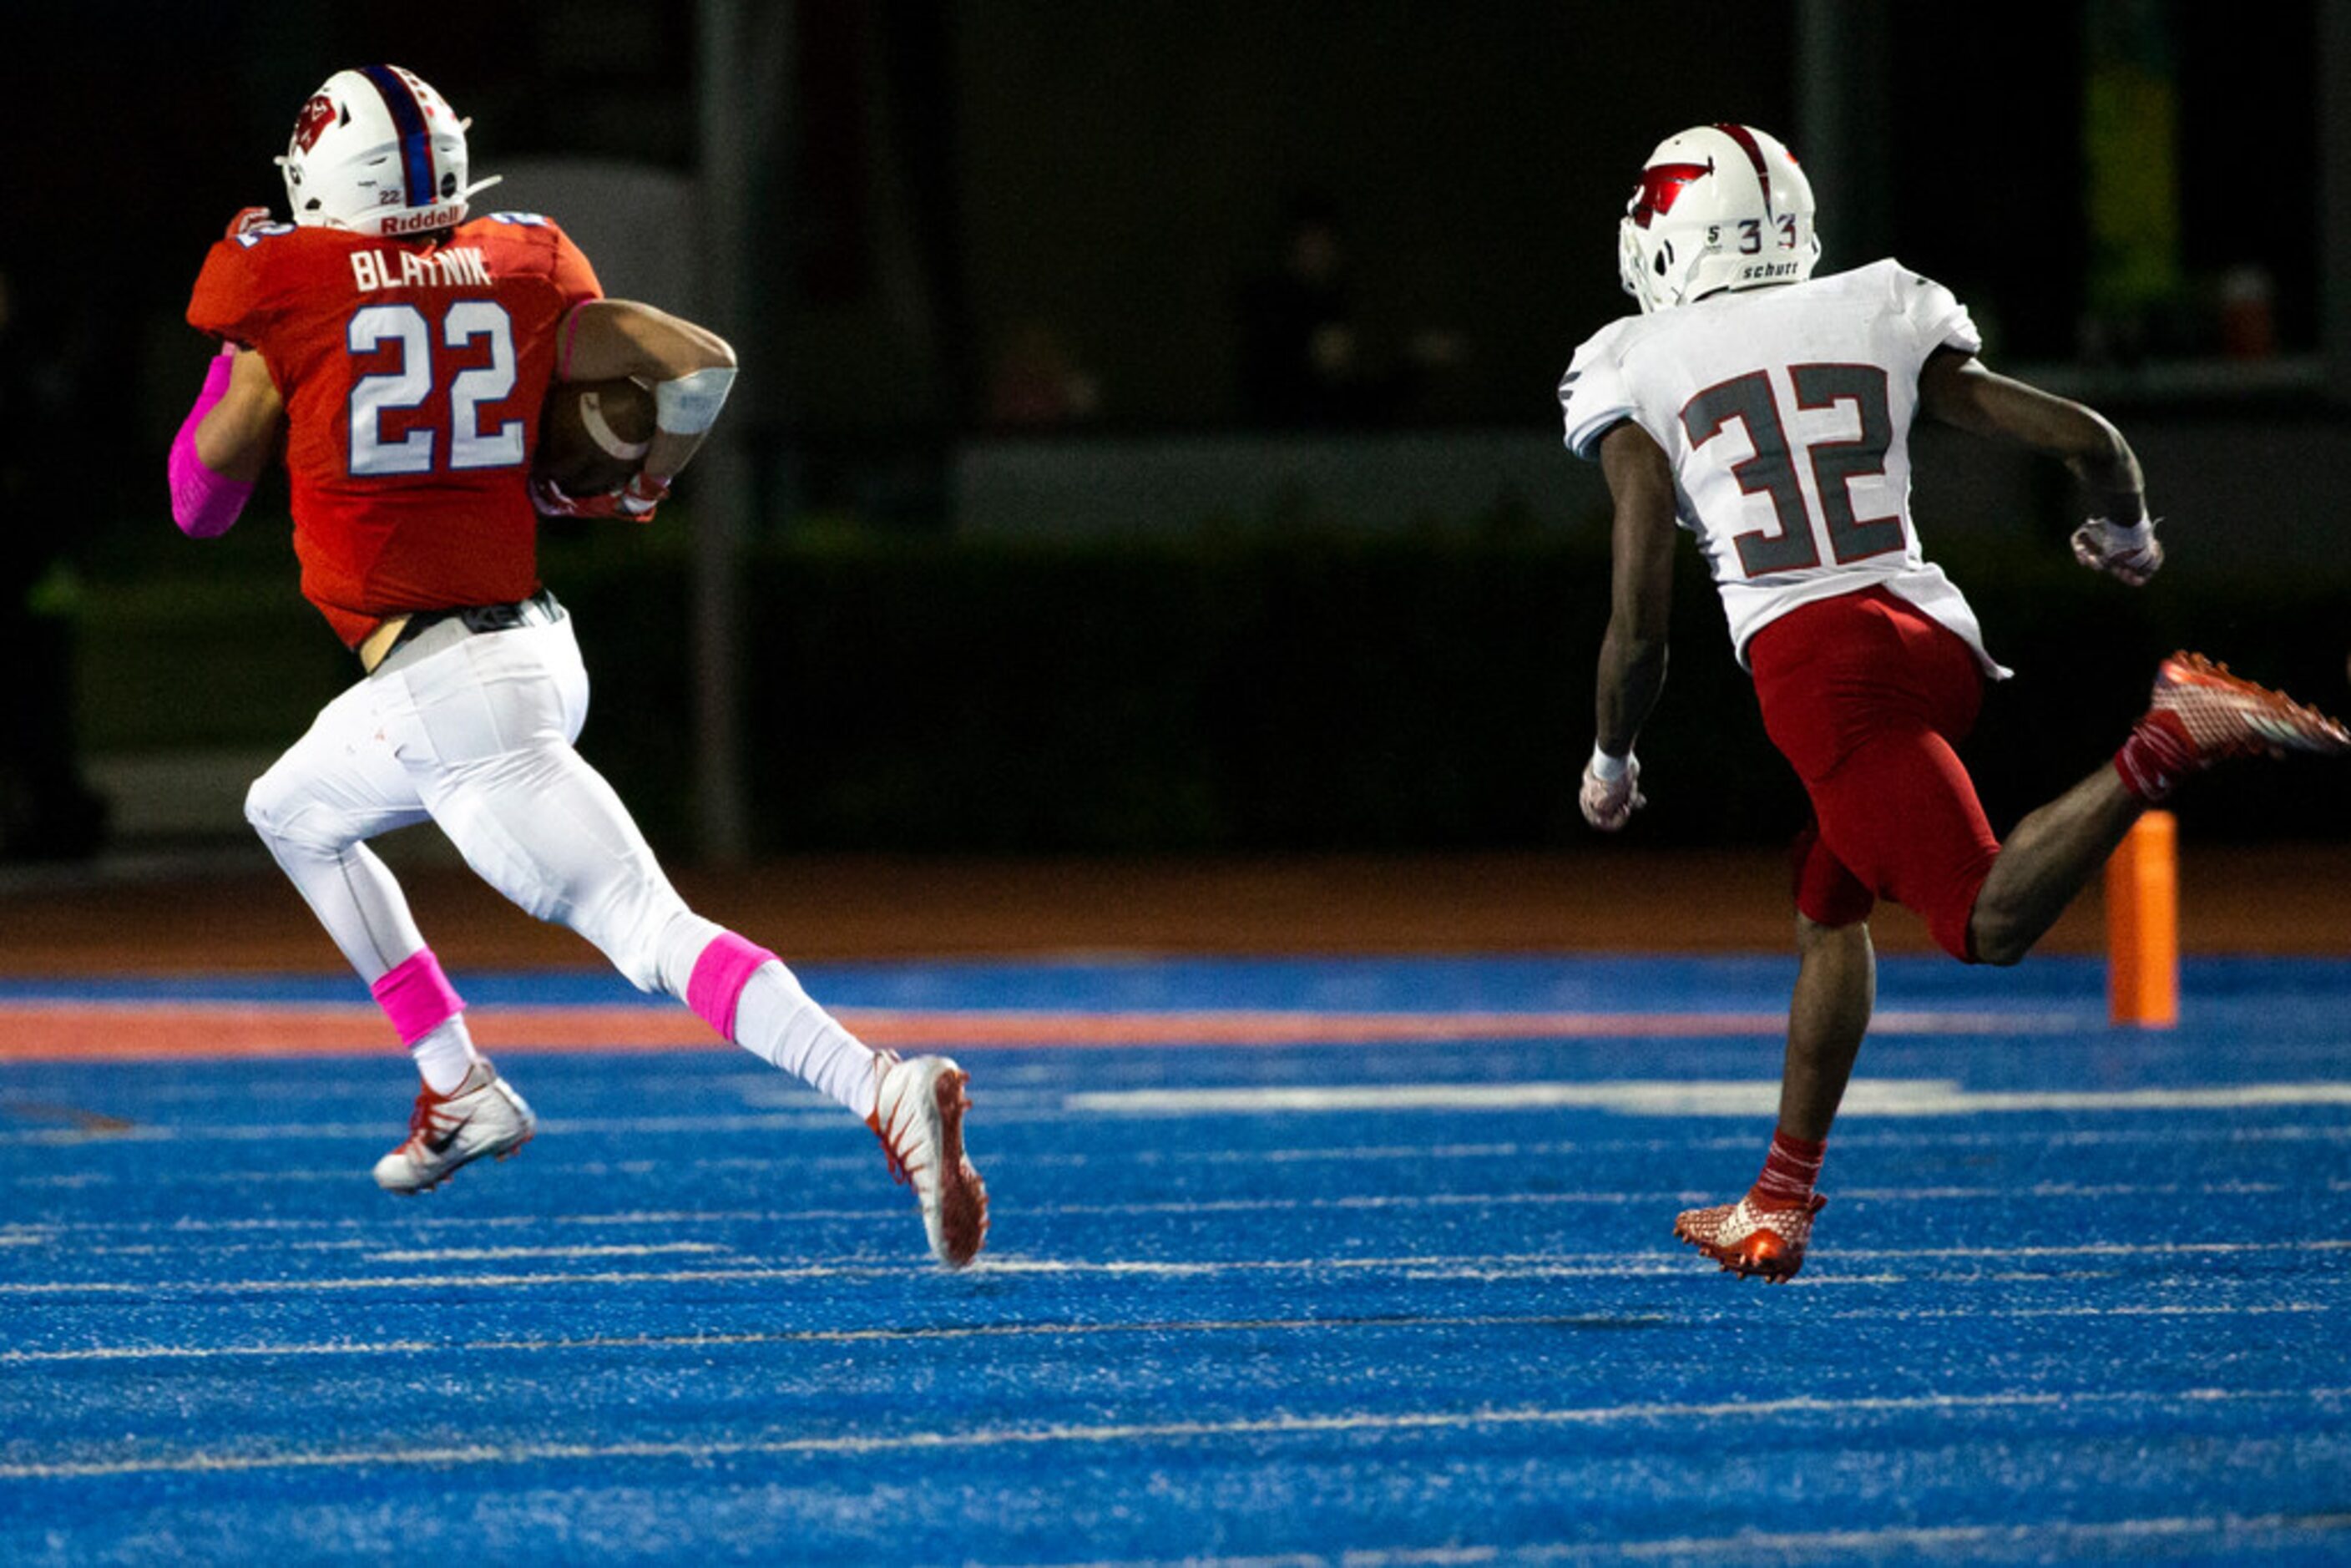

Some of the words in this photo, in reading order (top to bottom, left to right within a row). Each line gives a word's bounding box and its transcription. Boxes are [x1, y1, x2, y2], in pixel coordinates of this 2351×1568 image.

[380, 190, 401, 205] 22
[381, 205, 459, 234] Riddell
[350, 247, 493, 292] BLATNIK
[1743, 260, 1798, 279] schutt
[347, 299, 525, 478] 22
[1677, 362, 1907, 579] 32
